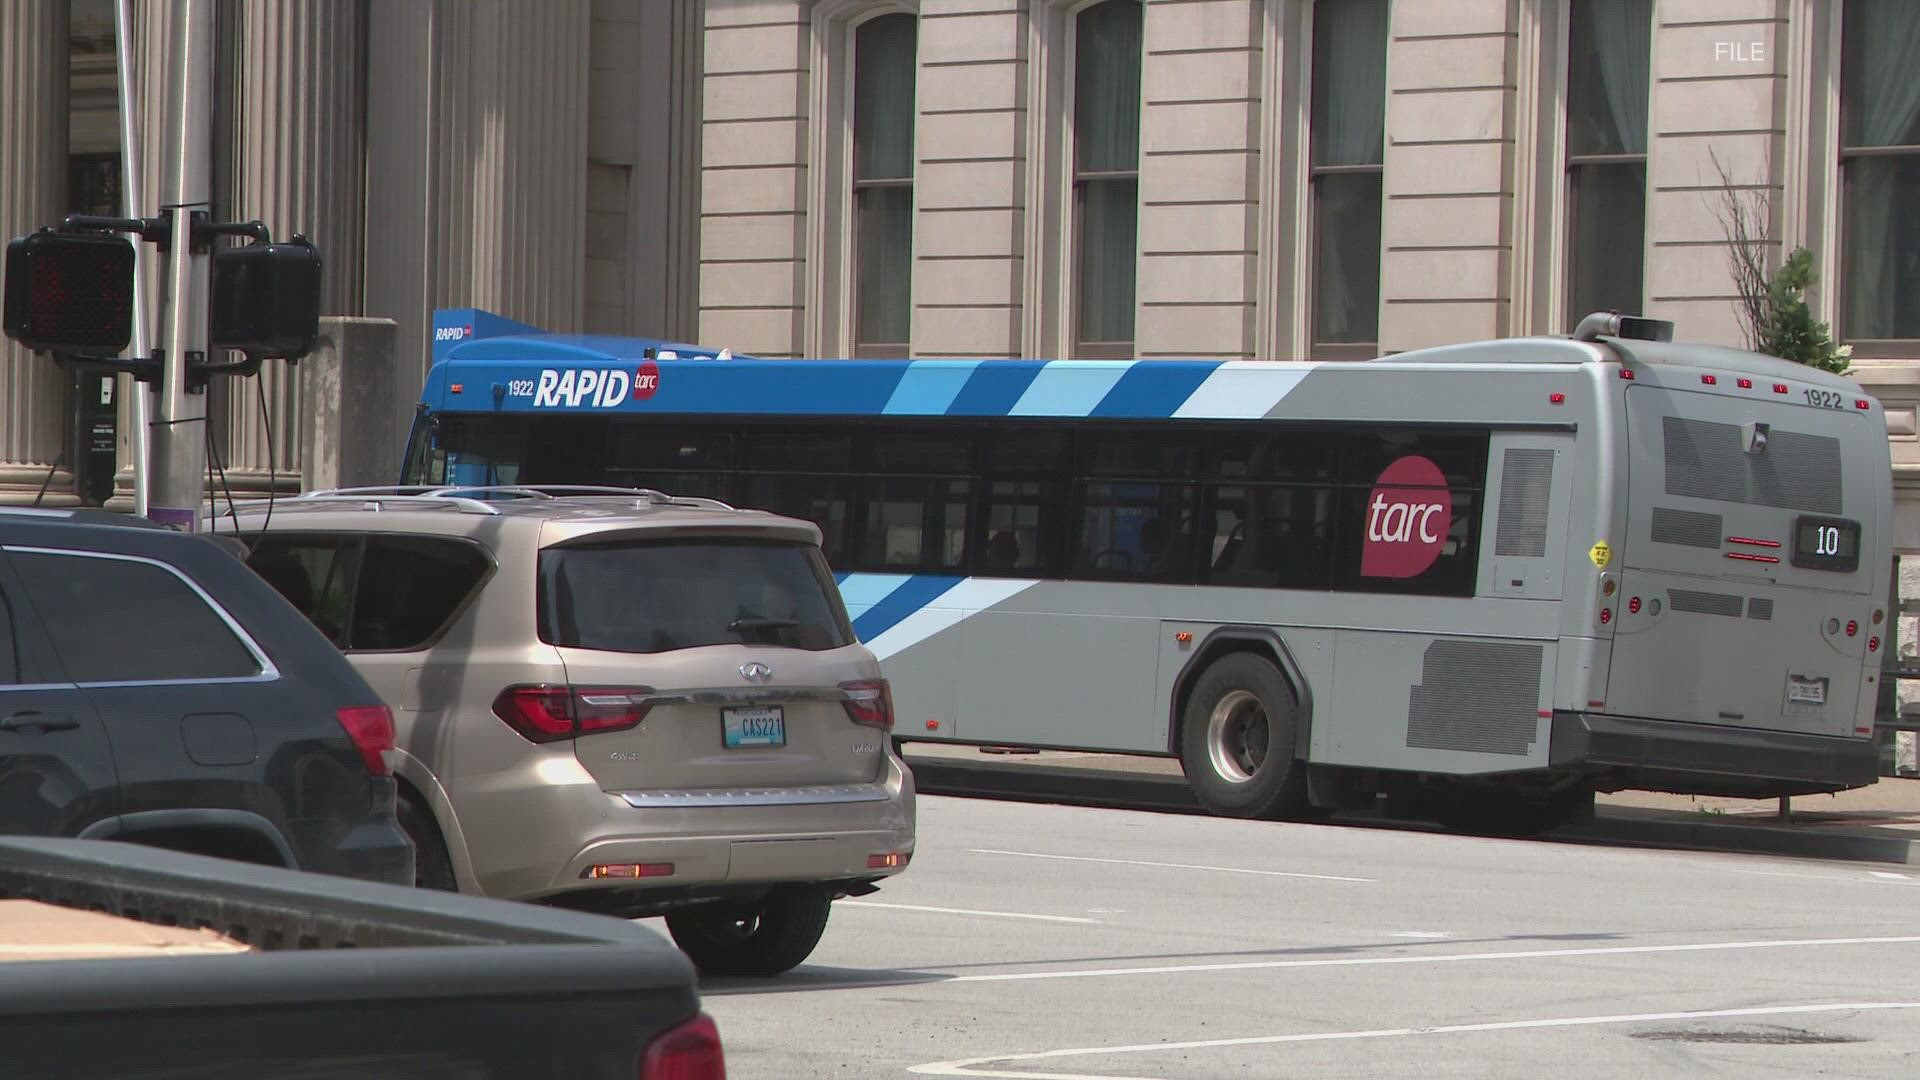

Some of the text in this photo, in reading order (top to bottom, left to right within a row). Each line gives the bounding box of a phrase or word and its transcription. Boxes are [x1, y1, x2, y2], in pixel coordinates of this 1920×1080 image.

[435, 327, 464, 341] RAPID
[508, 369, 657, 408] 1922 RAPID tarc
[1803, 388, 1843, 409] 1922
[1368, 492, 1443, 544] tarc
[1816, 526, 1839, 555] 10
[742, 718, 781, 737] CAS221
